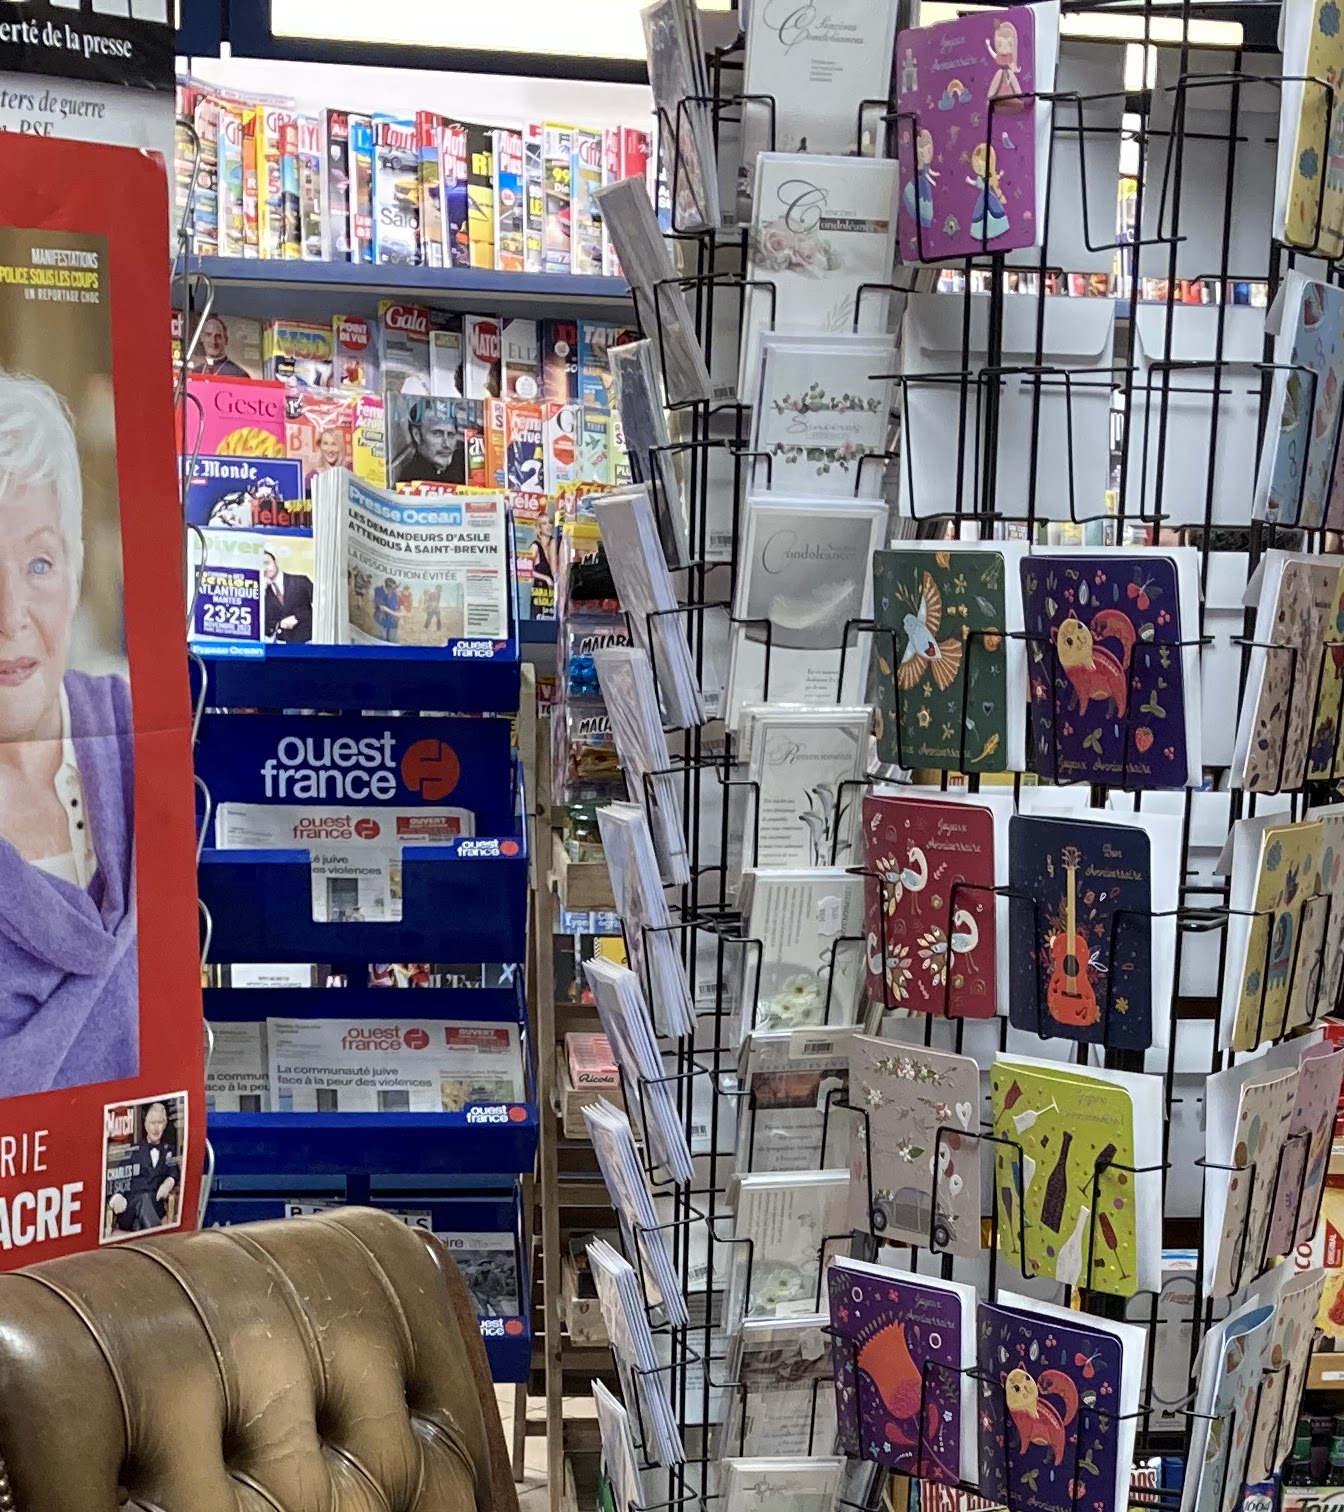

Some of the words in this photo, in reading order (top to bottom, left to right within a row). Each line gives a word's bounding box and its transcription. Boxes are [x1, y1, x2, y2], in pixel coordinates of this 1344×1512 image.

[42, 22, 62, 47] de
[66, 26, 80, 51] la
[83, 32, 133, 59] presse
[38, 89, 58, 113] de
[59, 98, 106, 120] guerre
[31, 248, 98, 269] MANIFESTATIONS
[30, 268, 54, 286] SOUS
[384, 305, 428, 333] Gala
[214, 390, 277, 418] Geste
[201, 460, 258, 480] Monde
[348, 520, 402, 552] ATTENDUS
[414, 544, 498, 554] SAINT-BREVIN
[367, 520, 444, 542] DEMANDEURS
[446, 533, 490, 542] D'ASILE
[277, 731, 396, 767] ouest
[261, 759, 396, 800] france
[299, 815, 352, 828] ouest
[292, 826, 352, 840] france
[328, 865, 382, 875] violences
[348, 1025, 401, 1040] ouest
[341, 1036, 402, 1051] france
[277, 1065, 291, 1074] La
[292, 1065, 371, 1076] communauté
[372, 1066, 399, 1078] juive
[578, 1073, 615, 1083] Ricola
[278, 1076, 302, 1085] face
[355, 1077, 376, 1087] des
[378, 1077, 432, 1088] violences
[466, 1113, 509, 1124] france
[470, 1105, 508, 1116] ouest
